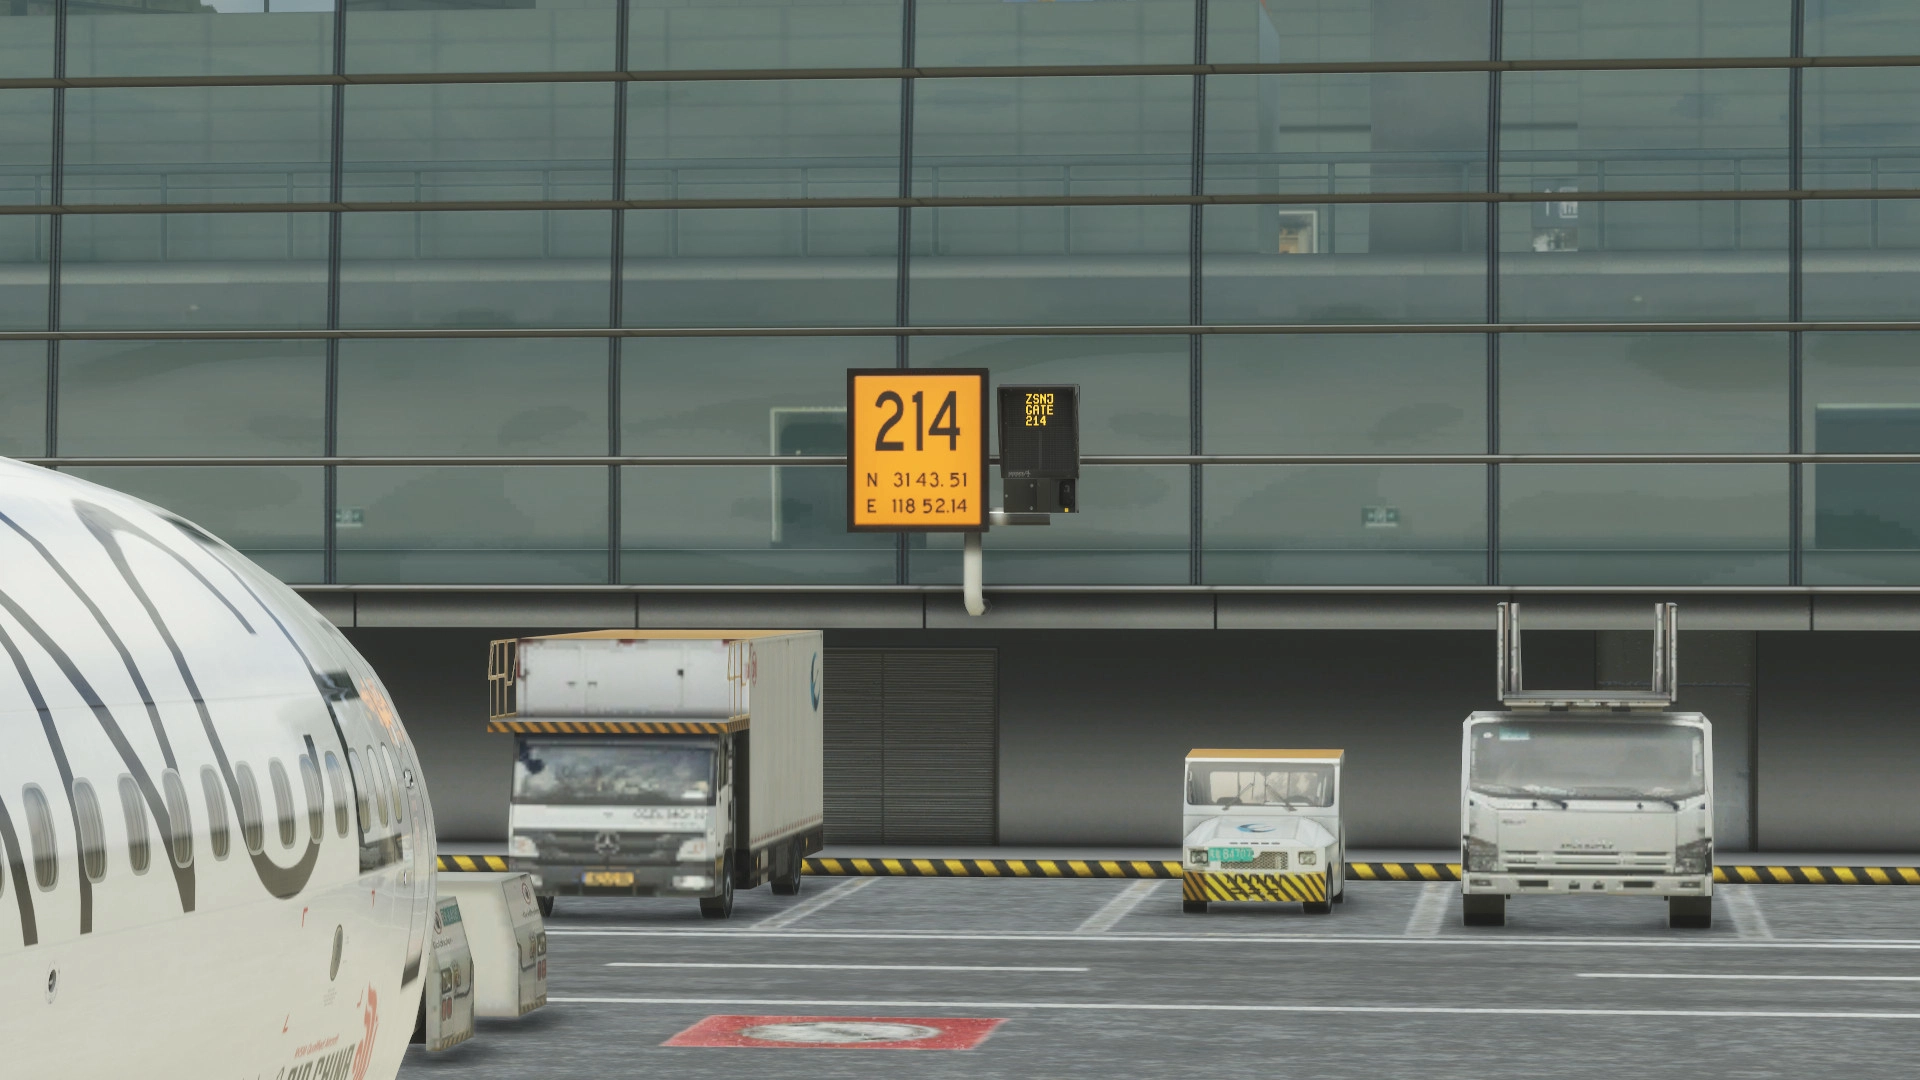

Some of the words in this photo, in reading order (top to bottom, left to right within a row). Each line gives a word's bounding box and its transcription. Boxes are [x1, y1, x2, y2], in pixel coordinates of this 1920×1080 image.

[1025, 393, 1054, 404] ZSNJ
[1025, 404, 1054, 415] GATE
[875, 391, 960, 451] 214
[1025, 415, 1047, 427] 214
[867, 472, 877, 487] N
[867, 498, 877, 513] E
